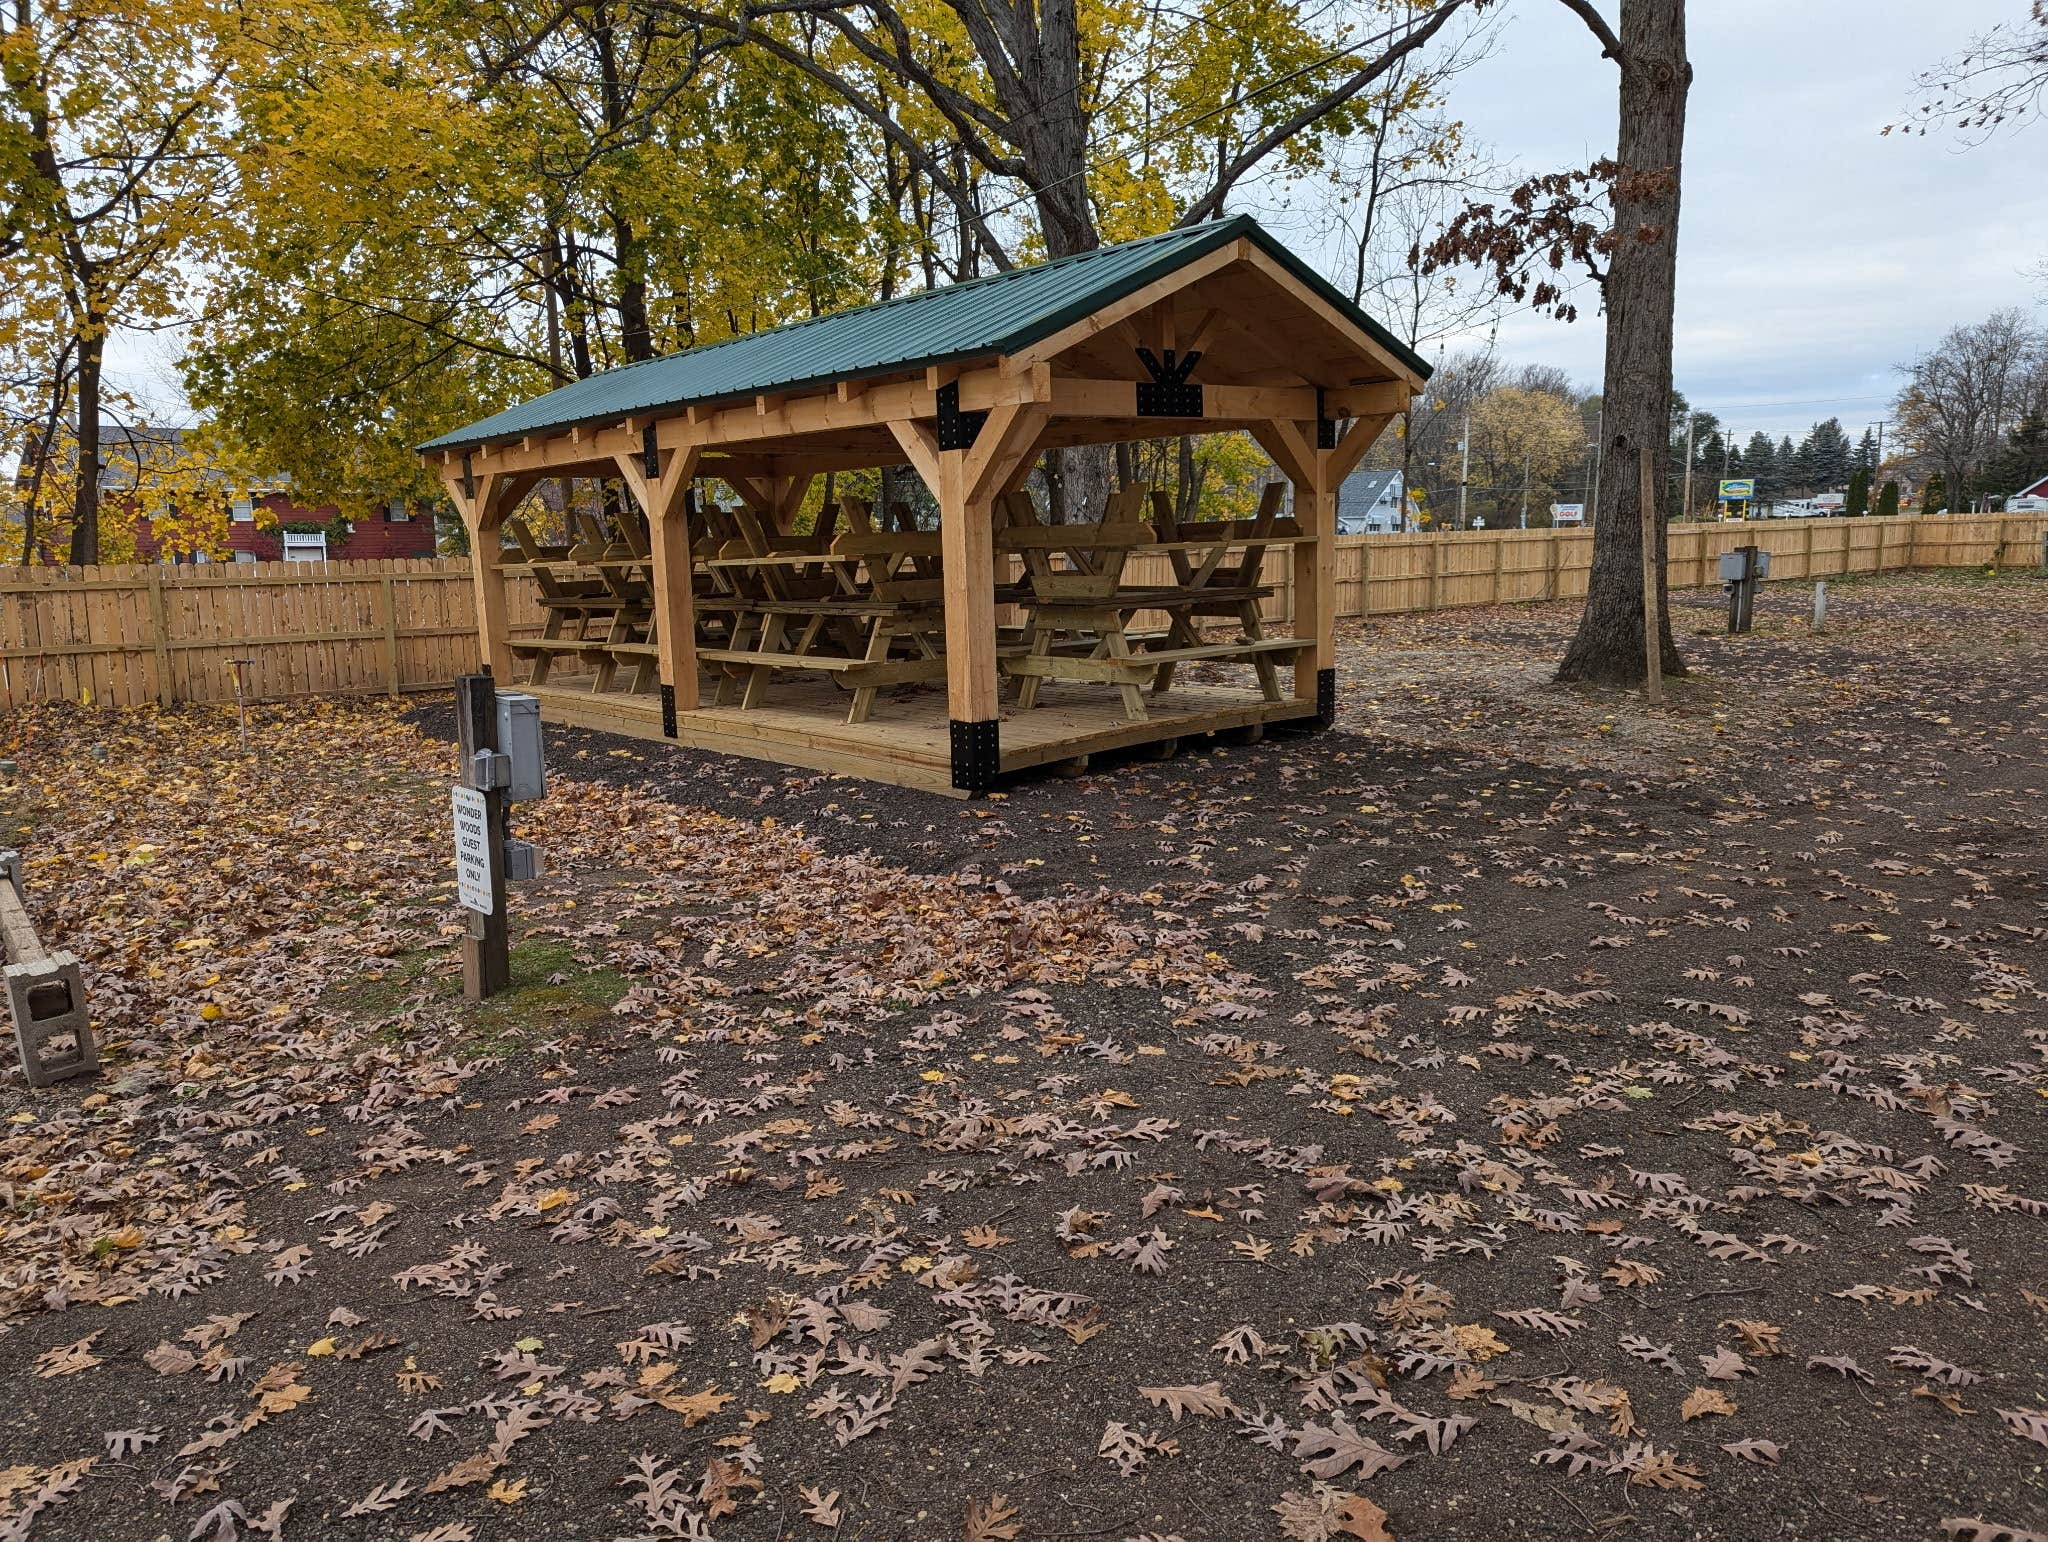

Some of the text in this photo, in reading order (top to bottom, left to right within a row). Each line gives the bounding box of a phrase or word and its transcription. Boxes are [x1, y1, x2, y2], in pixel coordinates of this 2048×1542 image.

[456, 804, 482, 820] WONDER
[459, 820, 481, 836] WOODS
[461, 836, 480, 851] GUEST
[460, 851, 485, 868] PARKING
[465, 868, 481, 882] ONLY
